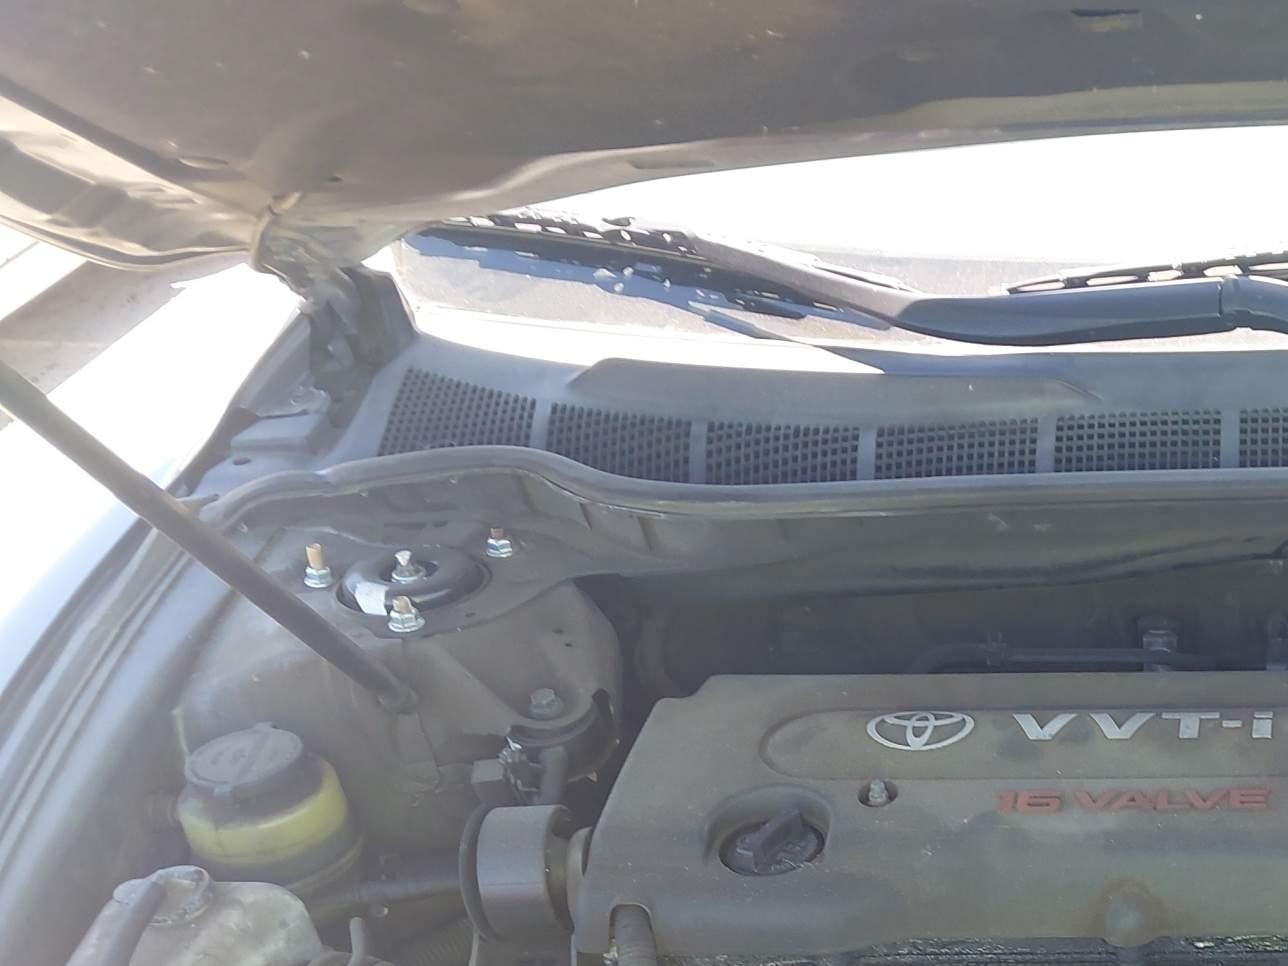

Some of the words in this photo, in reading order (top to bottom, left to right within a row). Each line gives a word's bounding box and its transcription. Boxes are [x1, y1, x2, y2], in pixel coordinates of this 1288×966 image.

[1012, 711, 1274, 741] VVT-i
[999, 790, 1065, 813] 16
[1076, 787, 1272, 812] VALVE
